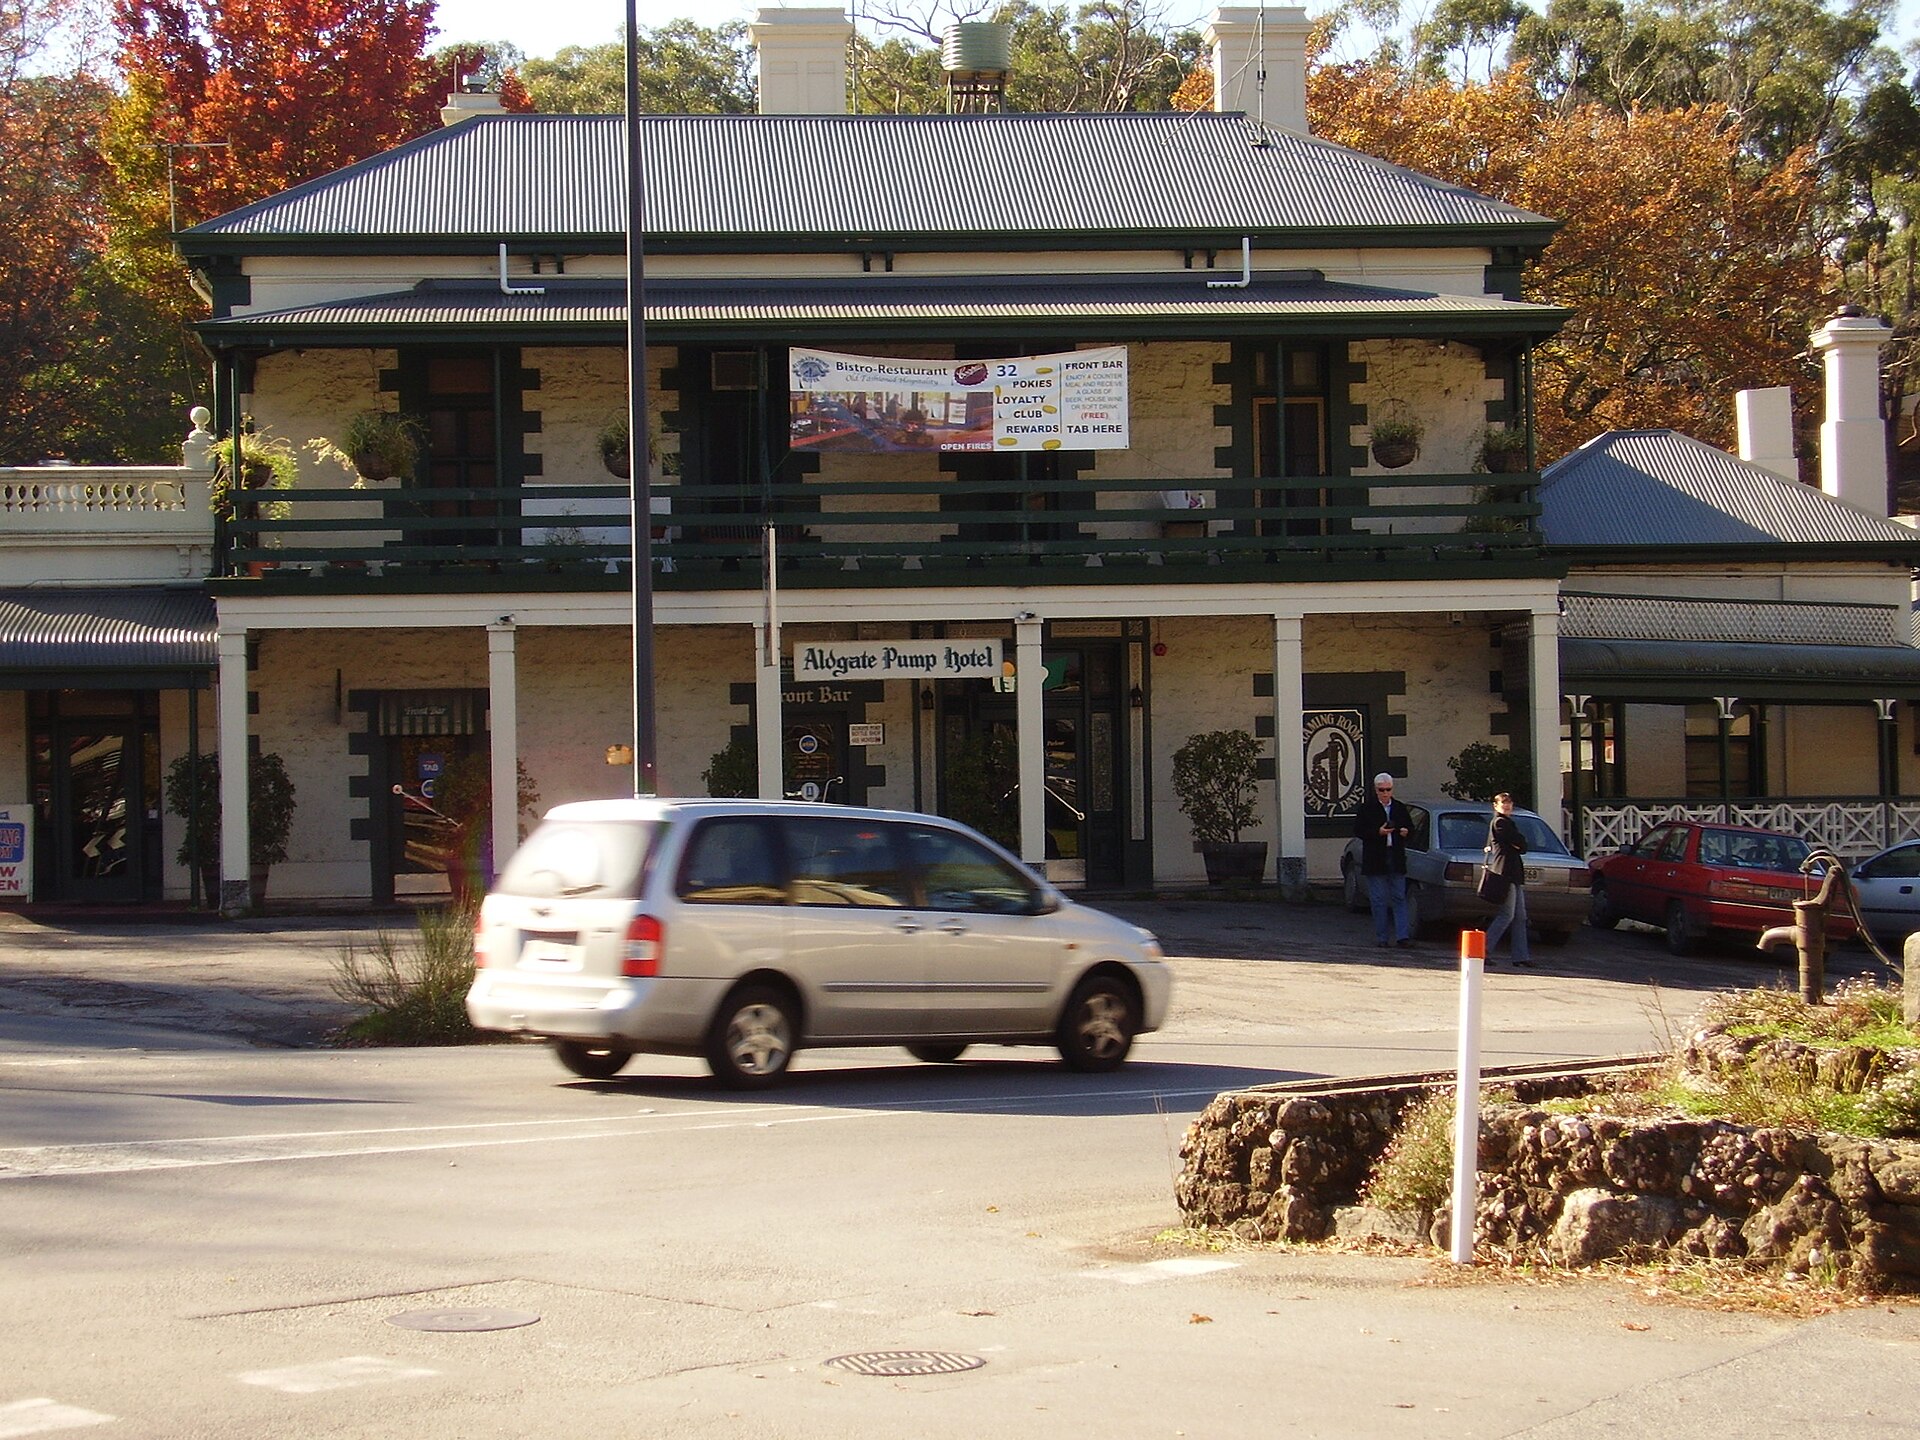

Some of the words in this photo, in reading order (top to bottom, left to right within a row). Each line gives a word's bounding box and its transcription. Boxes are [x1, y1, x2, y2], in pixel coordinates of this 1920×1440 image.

[836, 361, 948, 376] Bistro-Restaurant
[1065, 361, 1100, 370] FRONT
[1102, 360, 1123, 369] BAR
[996, 365, 1018, 377] 32
[1012, 380, 1052, 388] POKIES
[996, 395, 1046, 404] LOYALTY
[1013, 410, 1043, 418] CLUB
[1006, 425, 1059, 433] REWARDS
[1066, 425, 1089, 433] TAB
[1092, 425, 1122, 433] HERE
[940, 443, 965, 451] OPEN
[803, 647, 878, 677] Aldgate
[882, 647, 937, 672] Pump
[782, 690, 814, 704] ront
[818, 686, 852, 704] Bar
[1336, 715, 1361, 743] ROOM
[1303, 783, 1325, 812] OPEN
[1327, 803, 1337, 818] 7
[1339, 785, 1366, 812] DAYS
